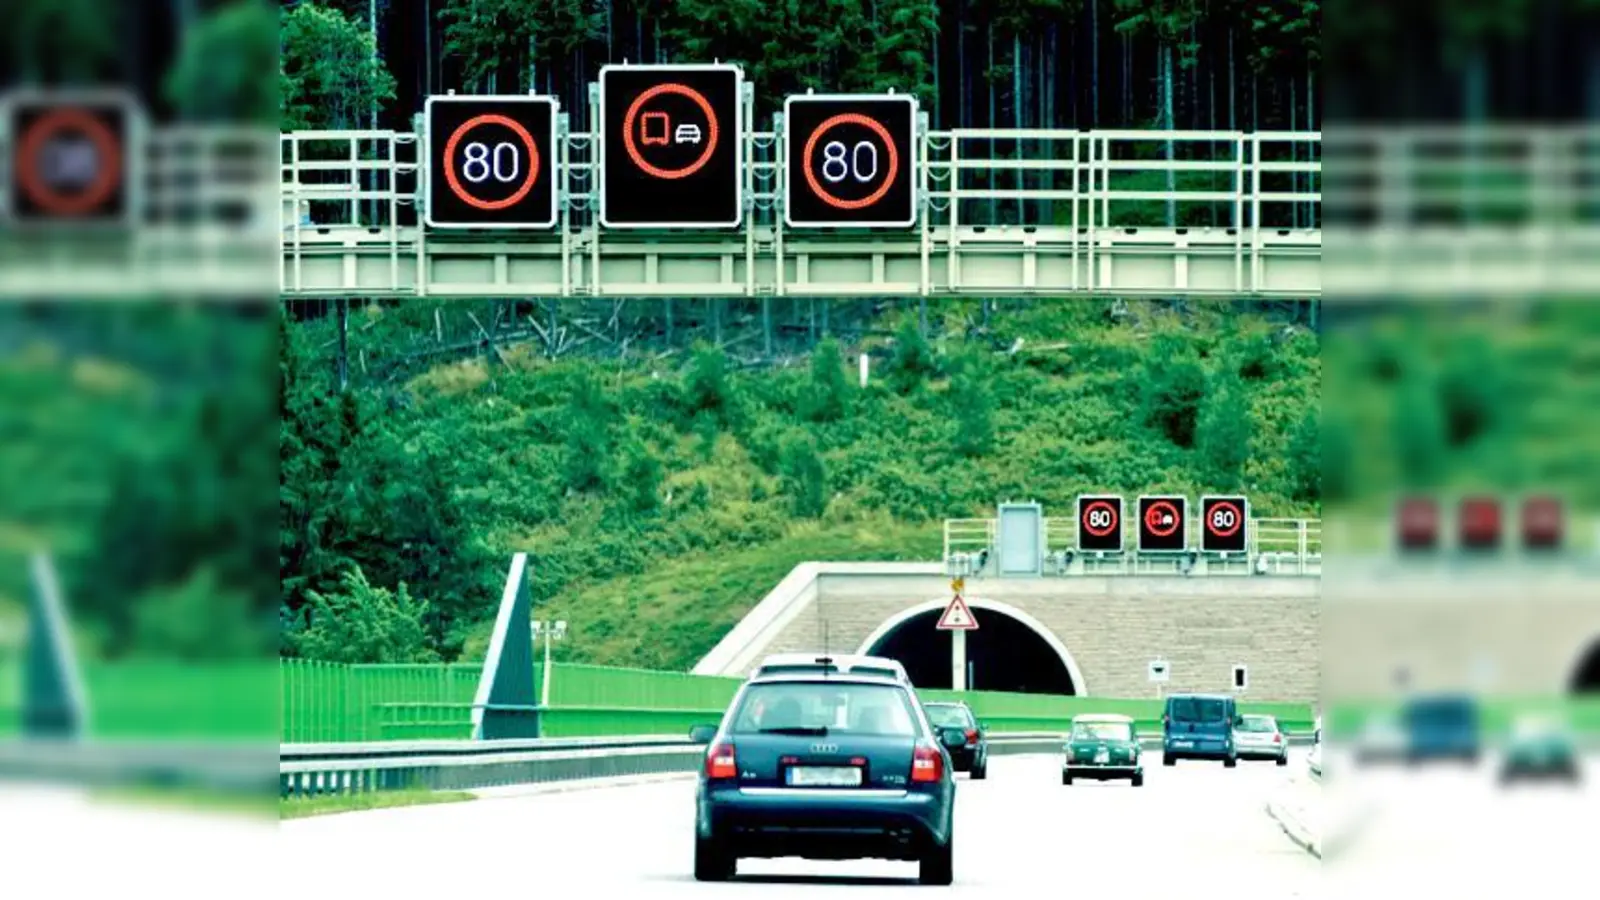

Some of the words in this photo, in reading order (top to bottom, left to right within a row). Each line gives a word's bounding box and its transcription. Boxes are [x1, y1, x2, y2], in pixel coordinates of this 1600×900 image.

[462, 141, 520, 183] 80
[822, 141, 878, 182] 80
[1090, 510, 1110, 527] 80
[1213, 510, 1234, 527] 80
